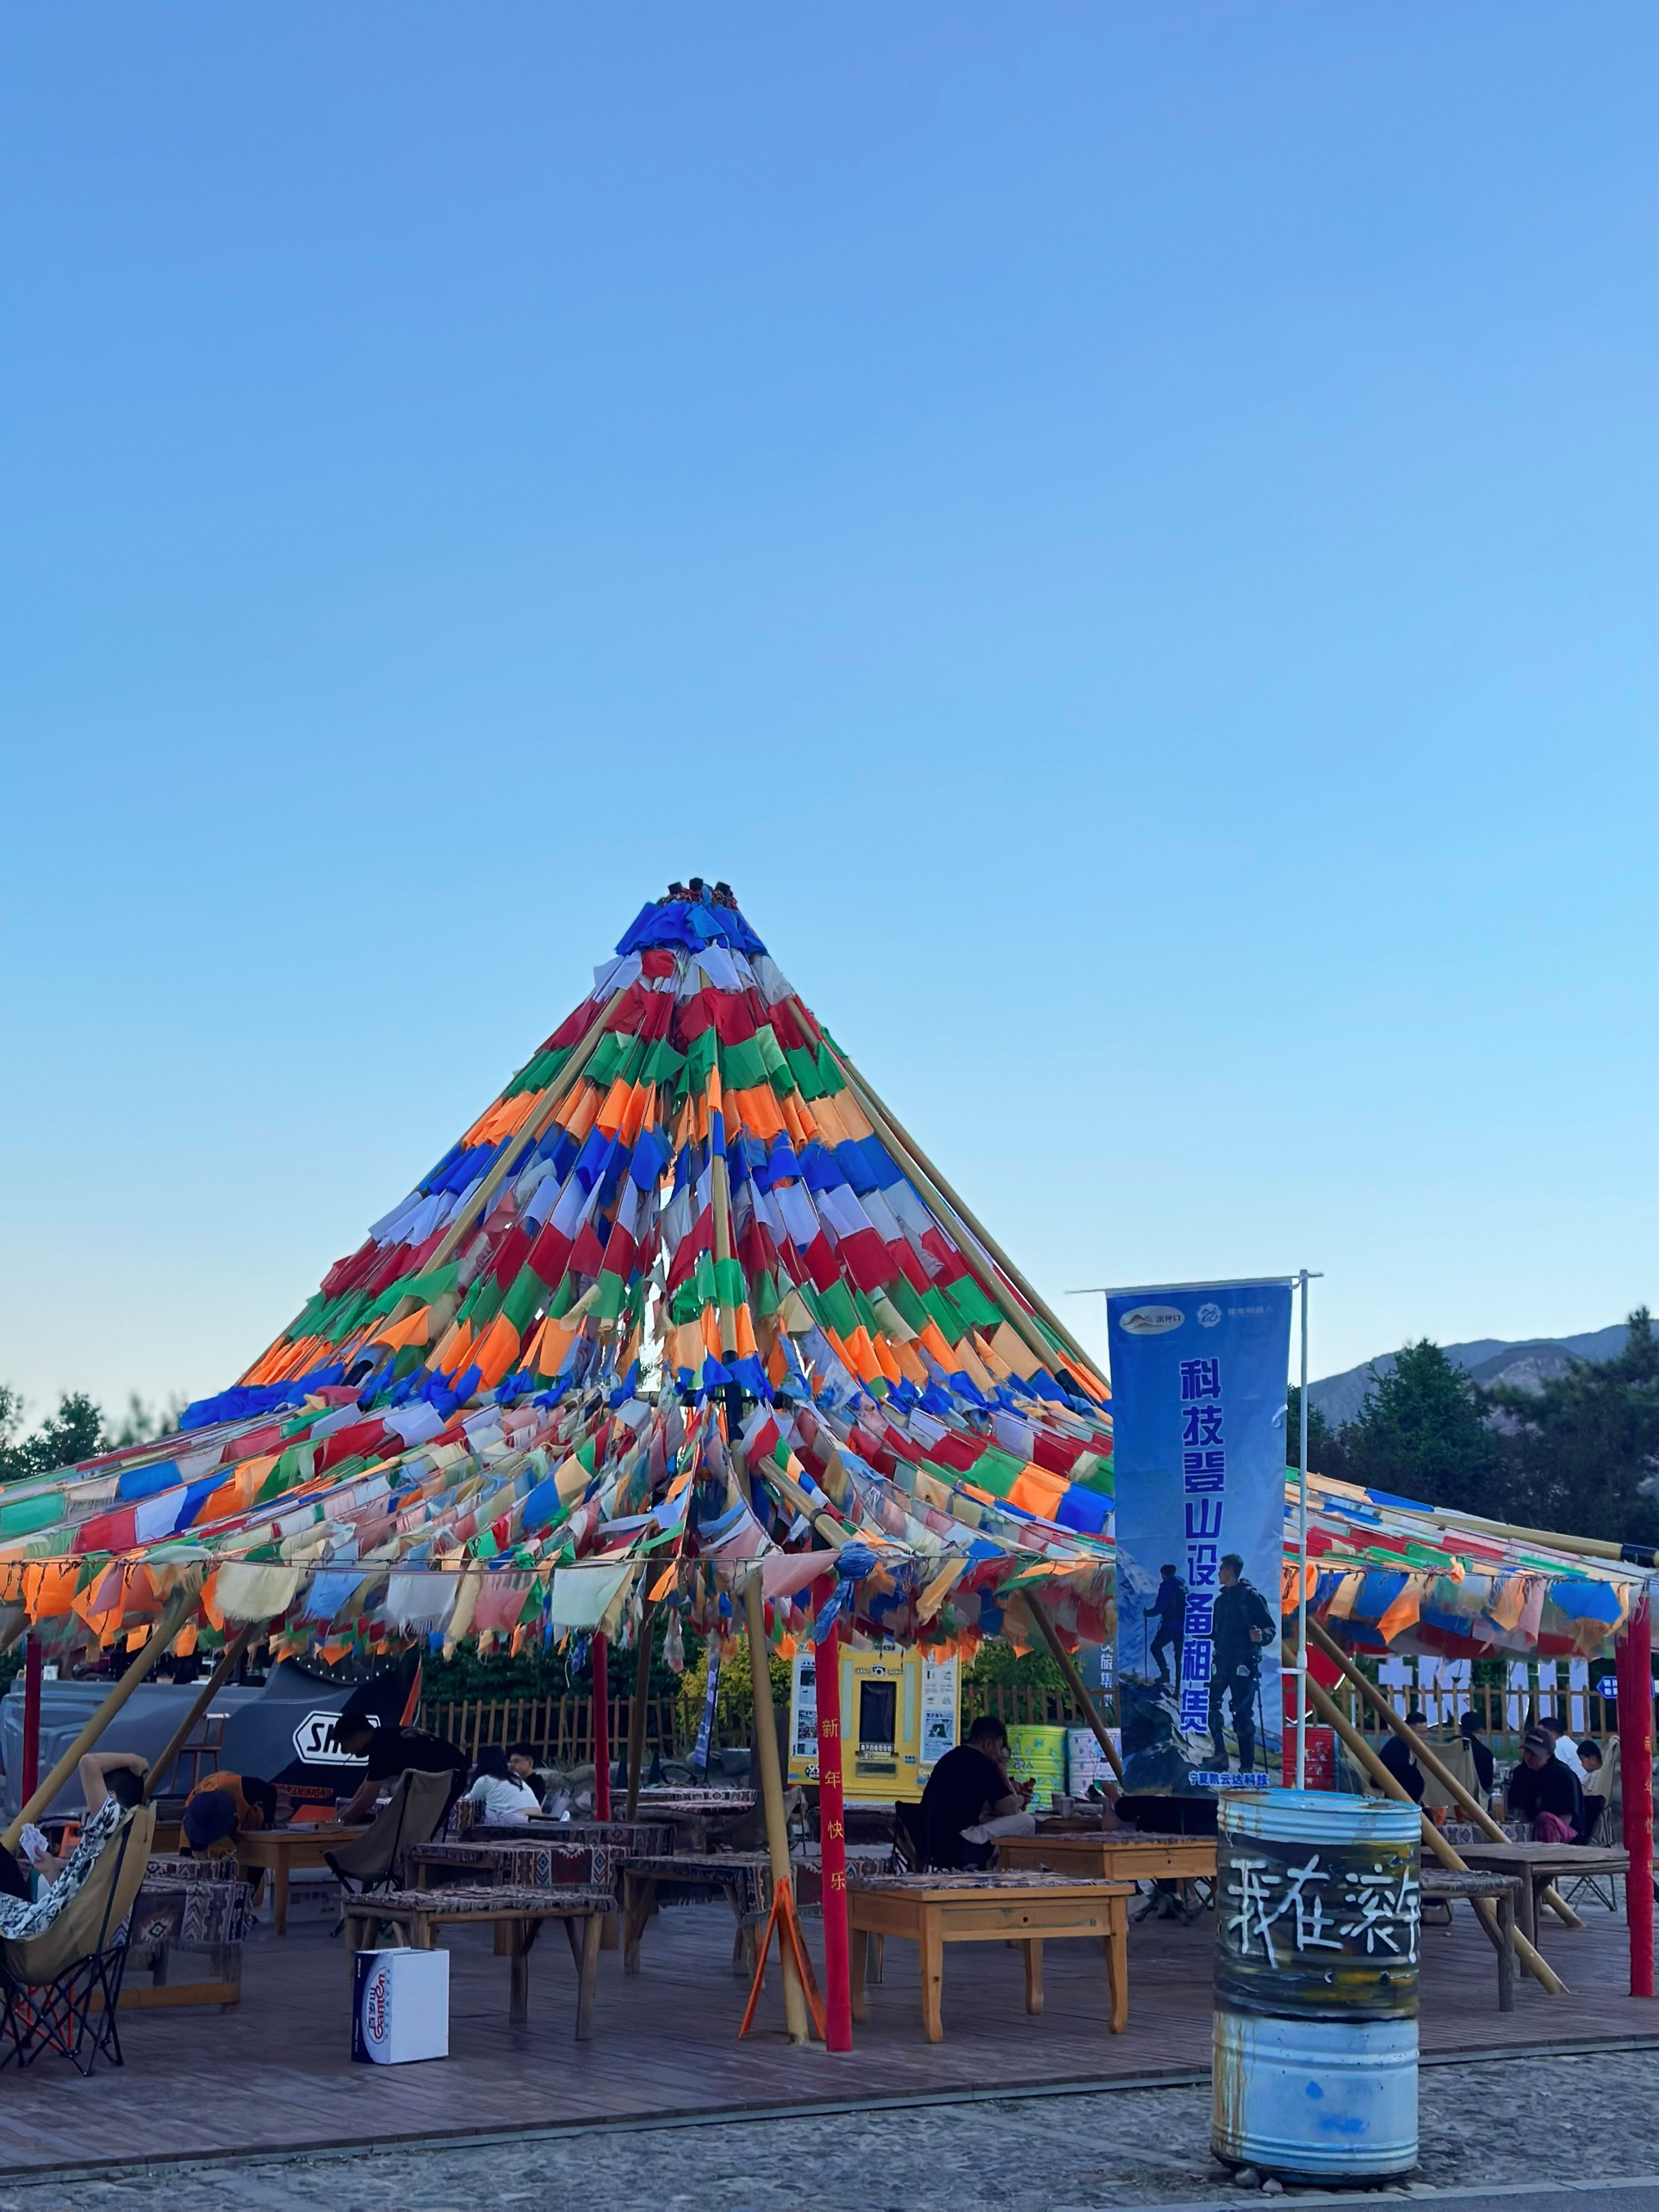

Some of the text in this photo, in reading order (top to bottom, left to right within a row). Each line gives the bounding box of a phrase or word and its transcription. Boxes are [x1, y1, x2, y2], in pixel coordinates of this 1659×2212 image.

[1180, 1358, 1224, 1733] 科技登山设备租赁
[822, 1718, 846, 1891] 新年快乐
